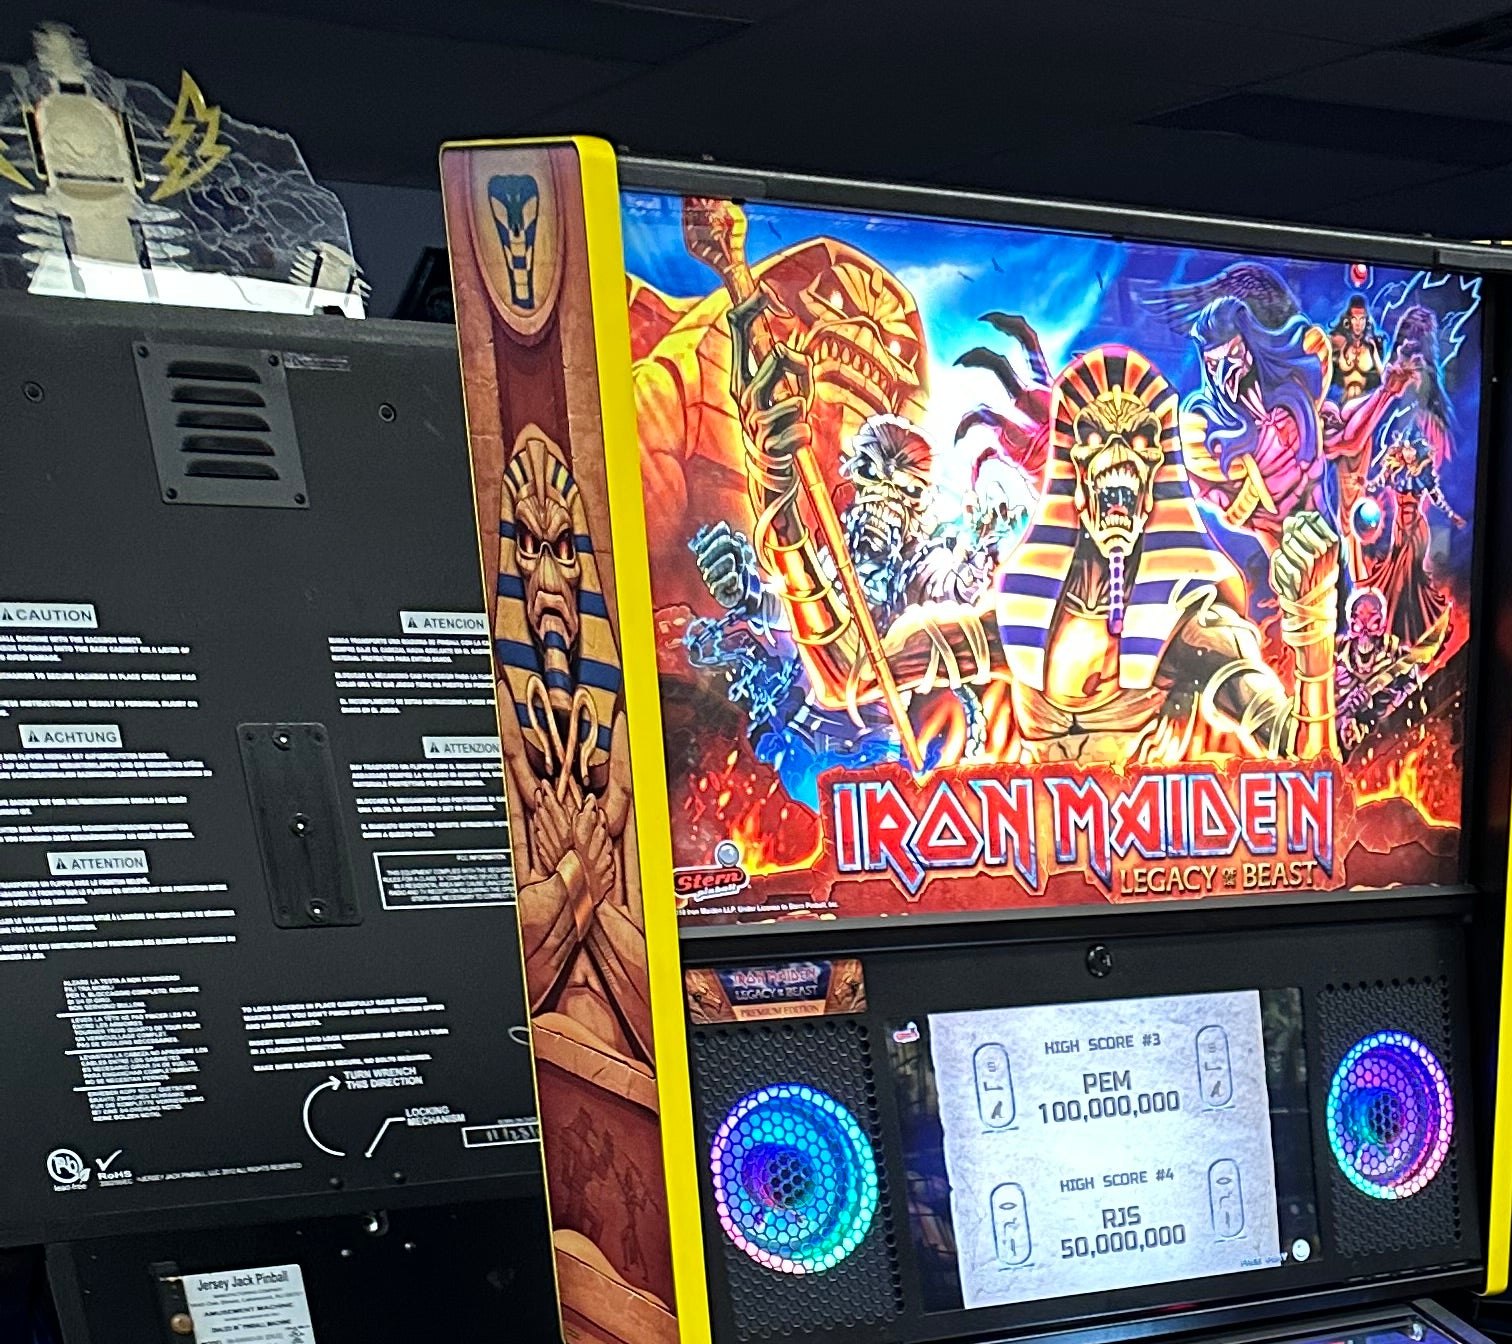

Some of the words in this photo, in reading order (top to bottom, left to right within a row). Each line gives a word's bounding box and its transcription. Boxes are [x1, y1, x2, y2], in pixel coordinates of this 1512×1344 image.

[16, 609, 92, 622] CAUTION
[423, 618, 484, 630] ATENCION
[44, 731, 117, 743] ACHTUNG
[443, 743, 500, 754] ATTENZION
[832, 780, 1040, 896] IRON
[1045, 773, 1336, 889] MAIDEN
[71, 857, 144, 871] ATTENTION
[676, 870, 741, 892] Stern
[1119, 866, 1216, 895] LEGACY
[1243, 862, 1318, 890] BEAST
[735, 986, 776, 1000] LEGACY
[785, 985, 818, 998] BEAST
[740, 1006, 782, 1018] PREMIUM
[784, 1004, 820, 1016] EDITION
[1044, 1039, 1080, 1056] HIGH
[1088, 1035, 1134, 1052] SCORE
[1142, 1032, 1162, 1048] #3
[344, 1070, 372, 1080] TURN
[373, 1067, 417, 1078] WRENCH
[346, 1080, 369, 1089] THIS
[370, 1076, 423, 1088] DIRECTION
[1083, 1070, 1132, 1095] PEM
[405, 1105, 450, 1116] LOCKING
[1038, 1090, 1181, 1125] 100,000,000
[407, 1113, 466, 1126] MECHANISM
[97, 1171, 132, 1180] RoHS
[1060, 1177, 1095, 1193] HIGH
[1103, 1171, 1148, 1189] SCORE
[1155, 1167, 1175, 1183] #4
[1102, 1205, 1142, 1230] RJS
[1060, 1224, 1187, 1260] 50,000,000
[197, 1279, 229, 1291] Jersey
[232, 1275, 254, 1288] Jack
[255, 1270, 289, 1285] Pinball
[204, 1307, 254, 1317] AMUSEMENT
